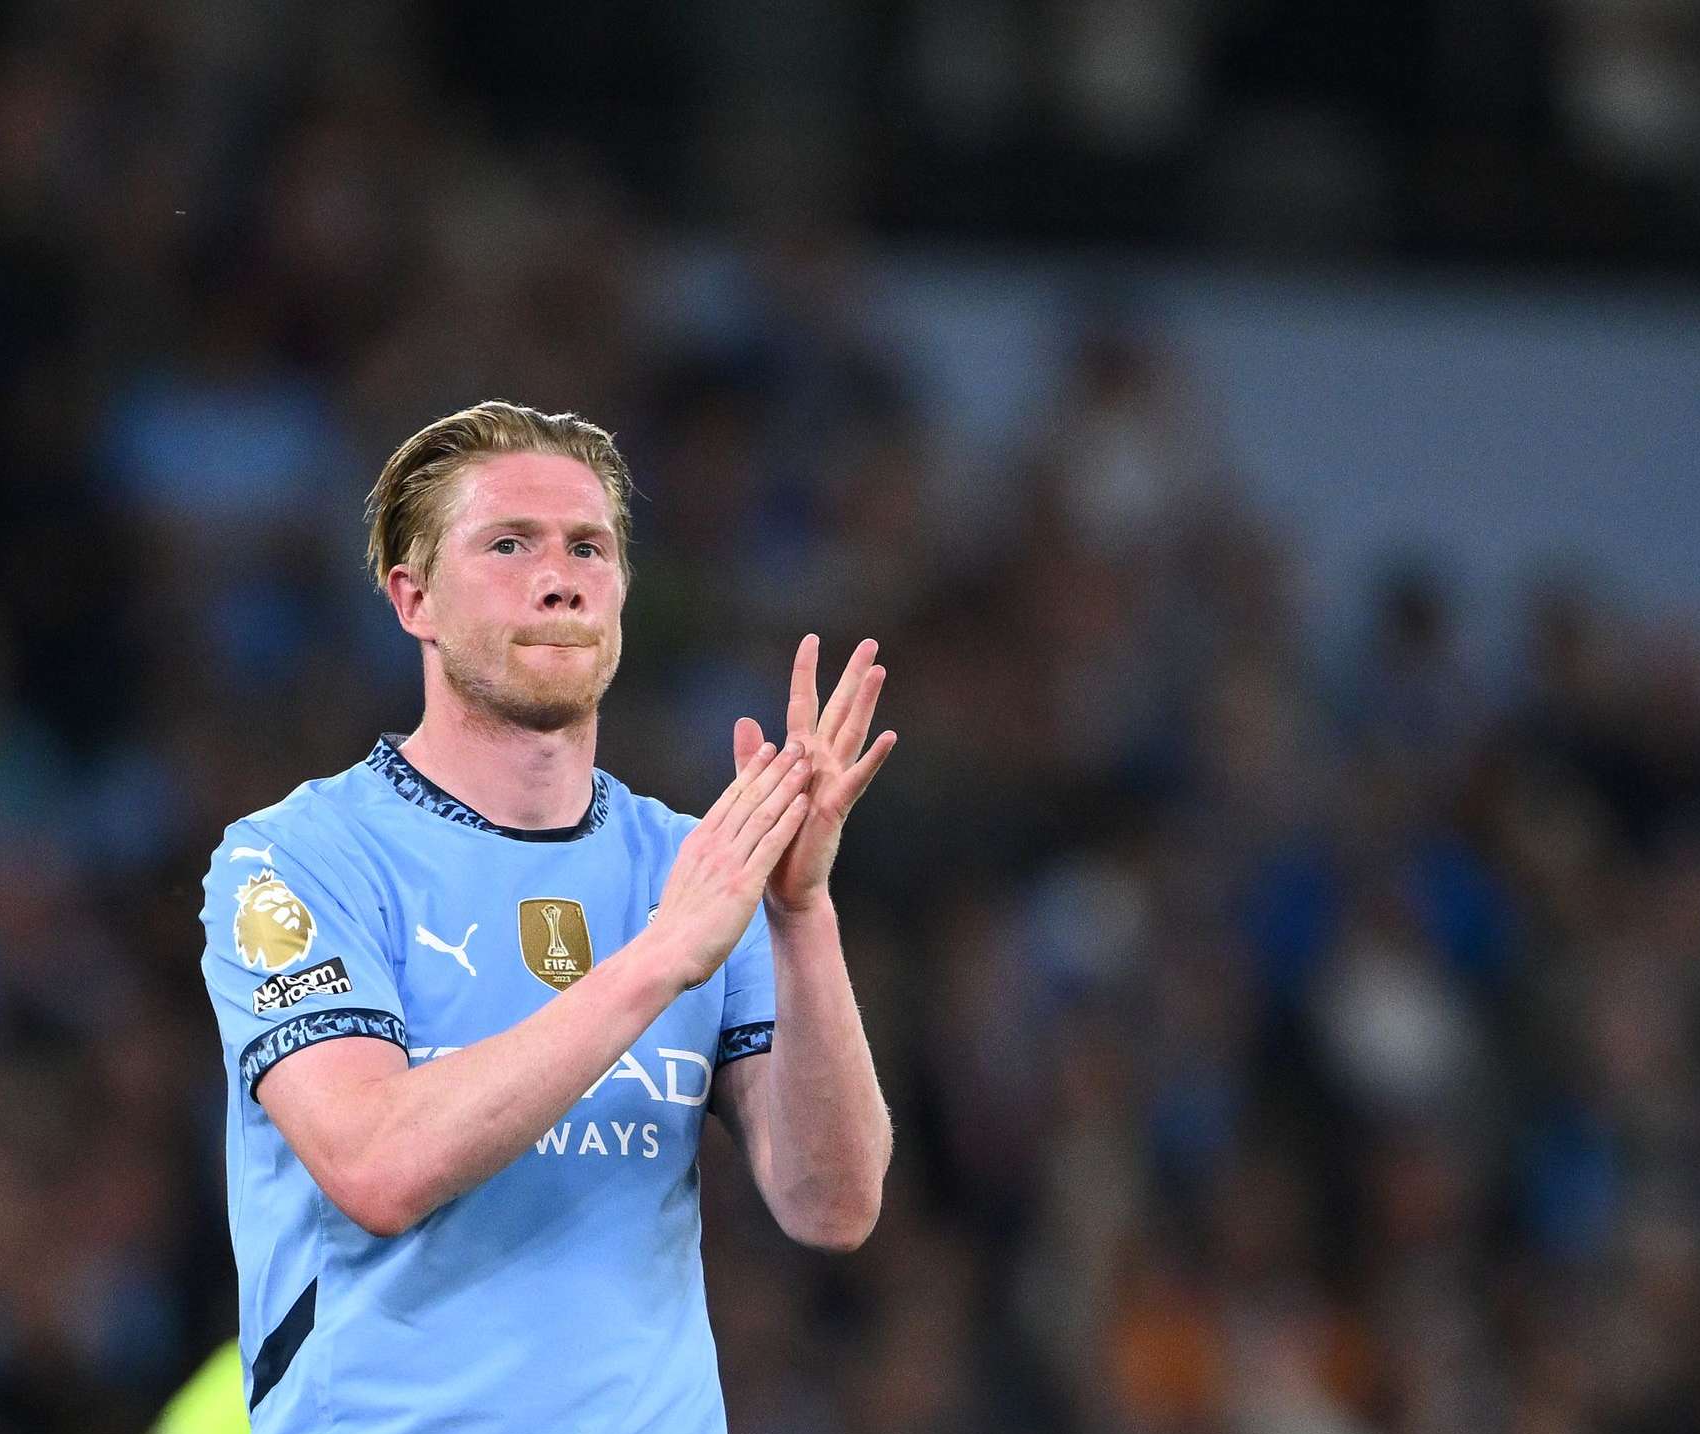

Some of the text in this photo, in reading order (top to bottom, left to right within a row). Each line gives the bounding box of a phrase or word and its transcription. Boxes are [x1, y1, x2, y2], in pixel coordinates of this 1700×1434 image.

[543, 958, 577, 971] FIFA
[252, 965, 337, 1003] No room
[535, 1121, 660, 1158] WAYS
